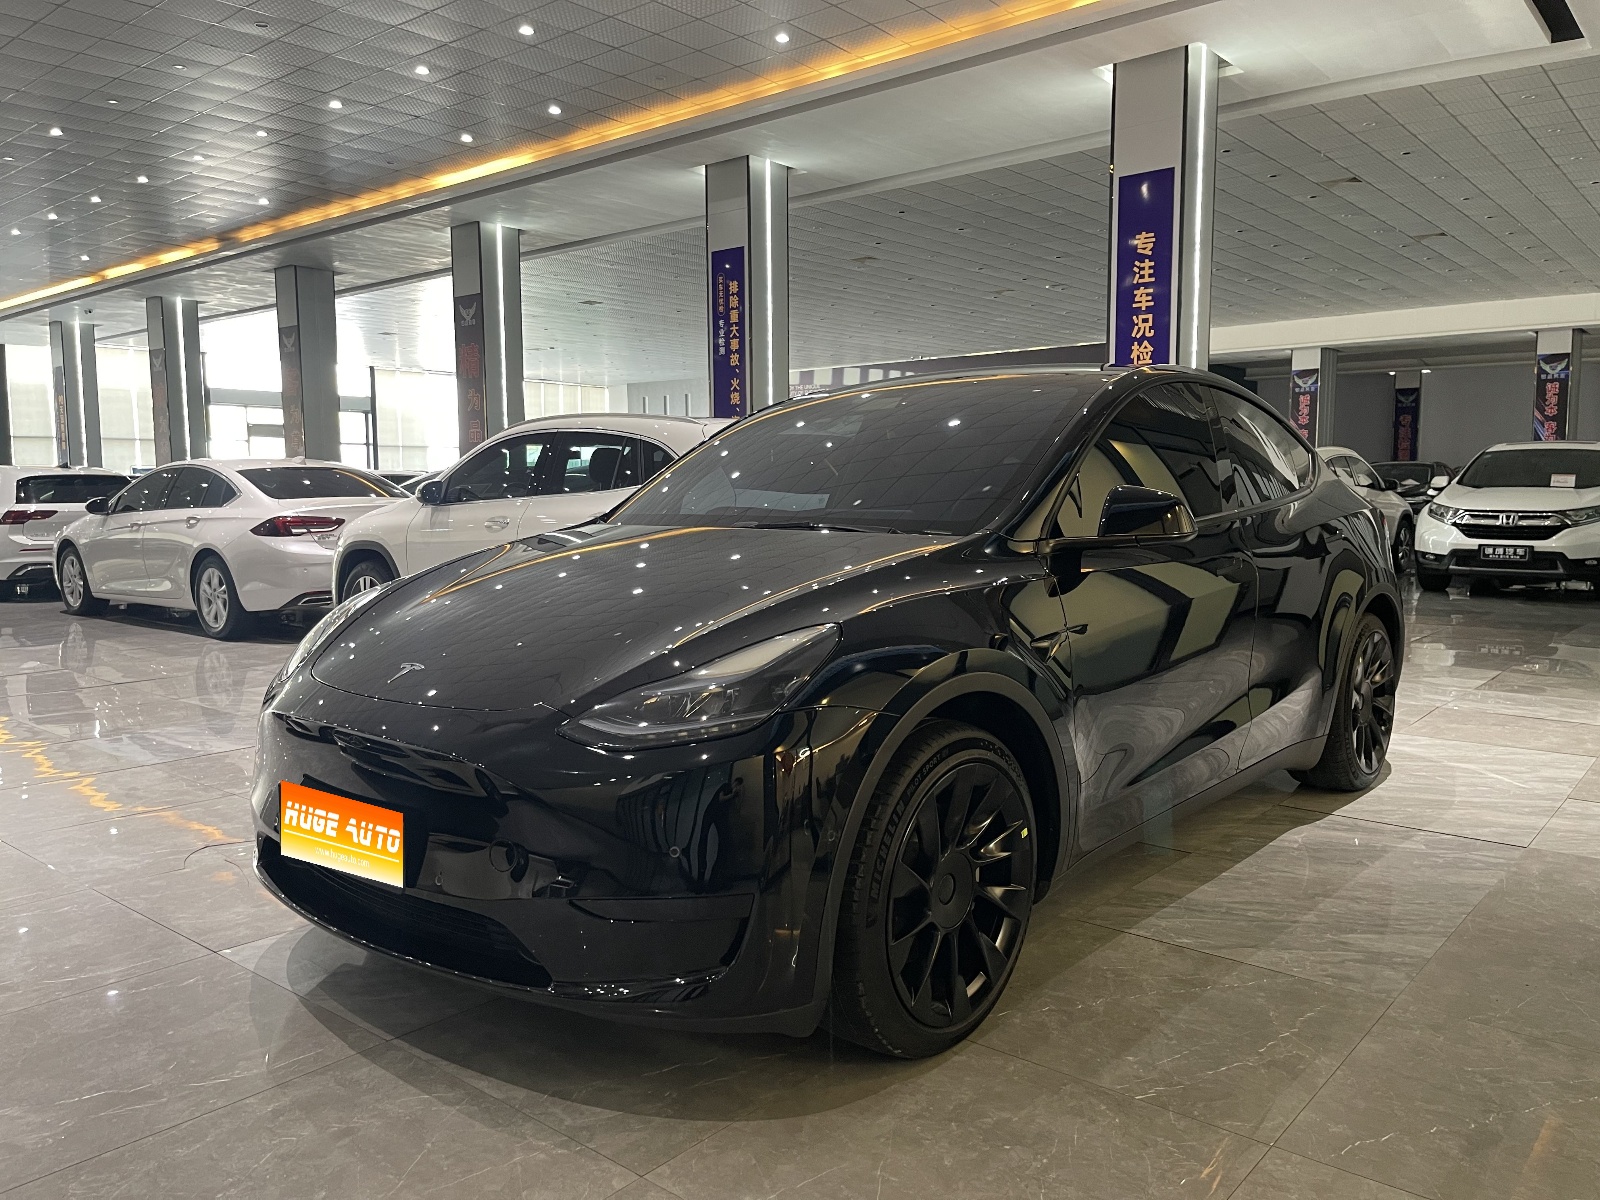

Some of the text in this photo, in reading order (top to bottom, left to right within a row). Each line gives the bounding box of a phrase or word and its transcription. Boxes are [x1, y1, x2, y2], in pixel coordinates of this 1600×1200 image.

[728, 280, 741, 419] 排除重大事故、火烧、
[1130, 231, 1156, 366] 专注车况检
